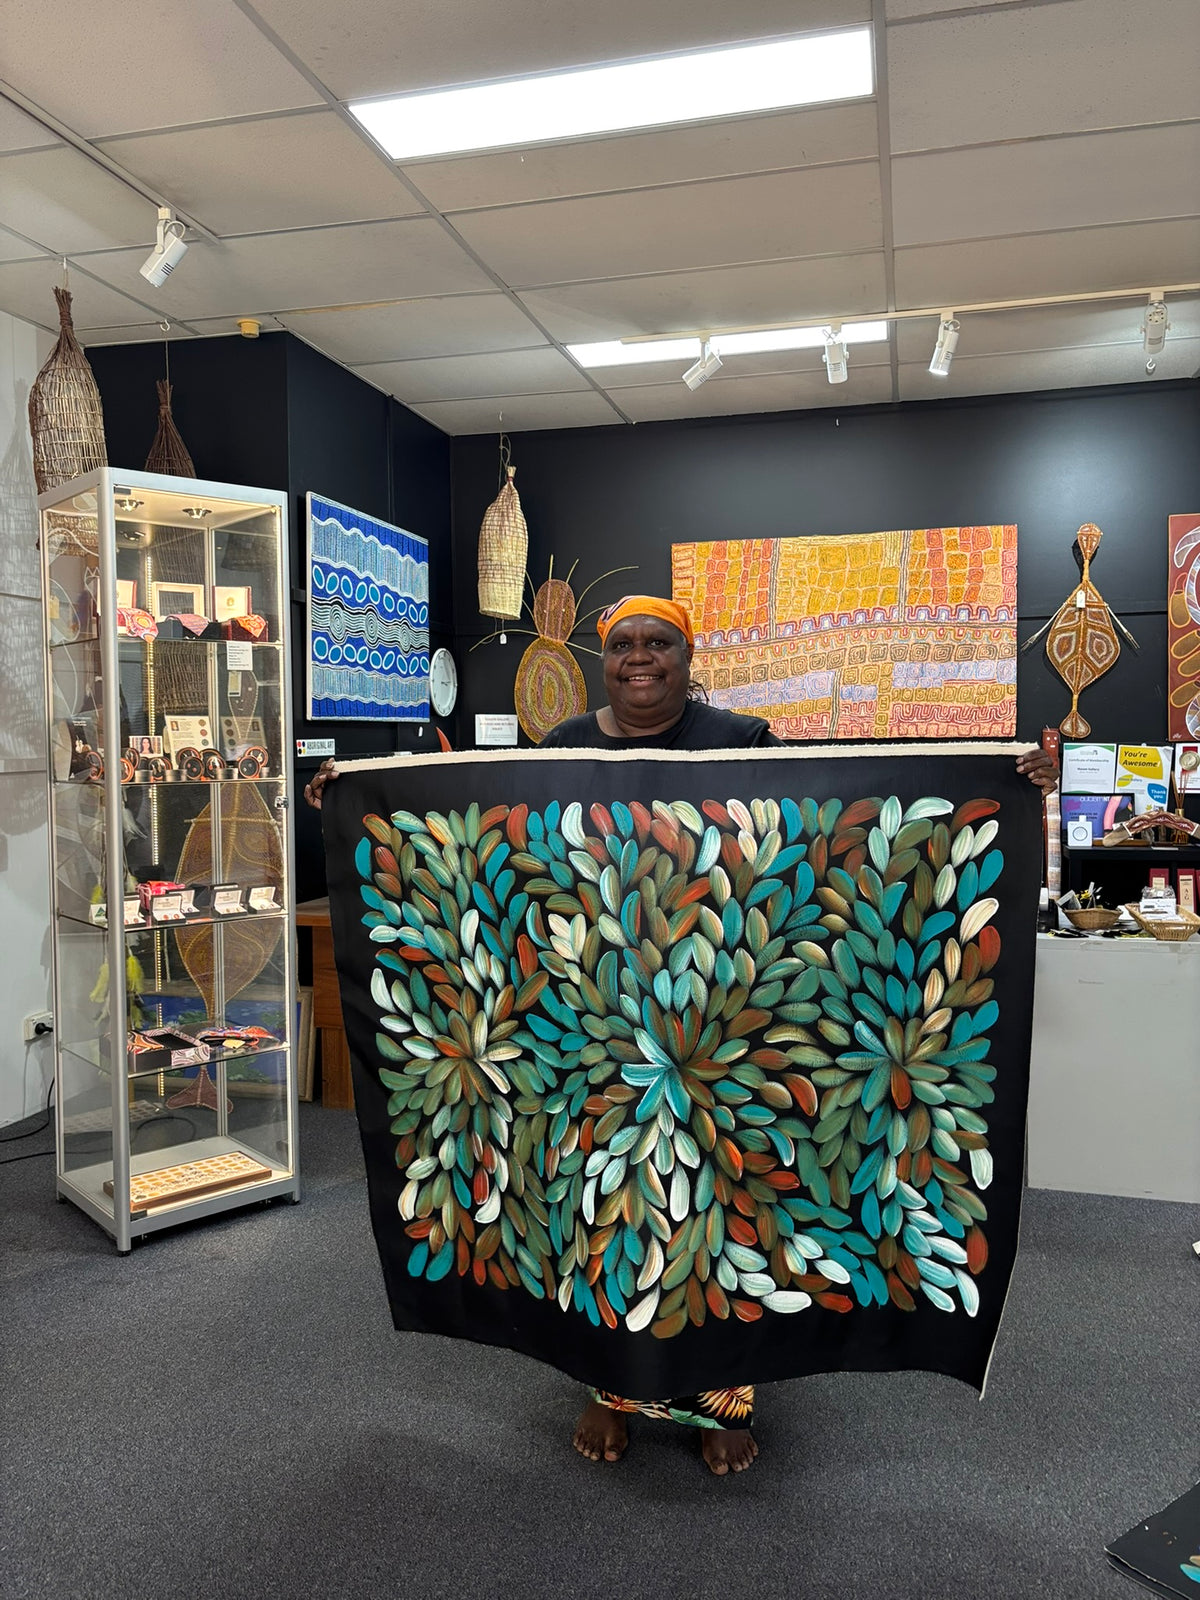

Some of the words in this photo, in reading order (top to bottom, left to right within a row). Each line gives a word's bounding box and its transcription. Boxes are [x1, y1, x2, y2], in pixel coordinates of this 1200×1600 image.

[307, 741, 327, 749] ABORIGINAL
[1123, 750, 1148, 758] You're
[1122, 759, 1161, 768] Awesome!
